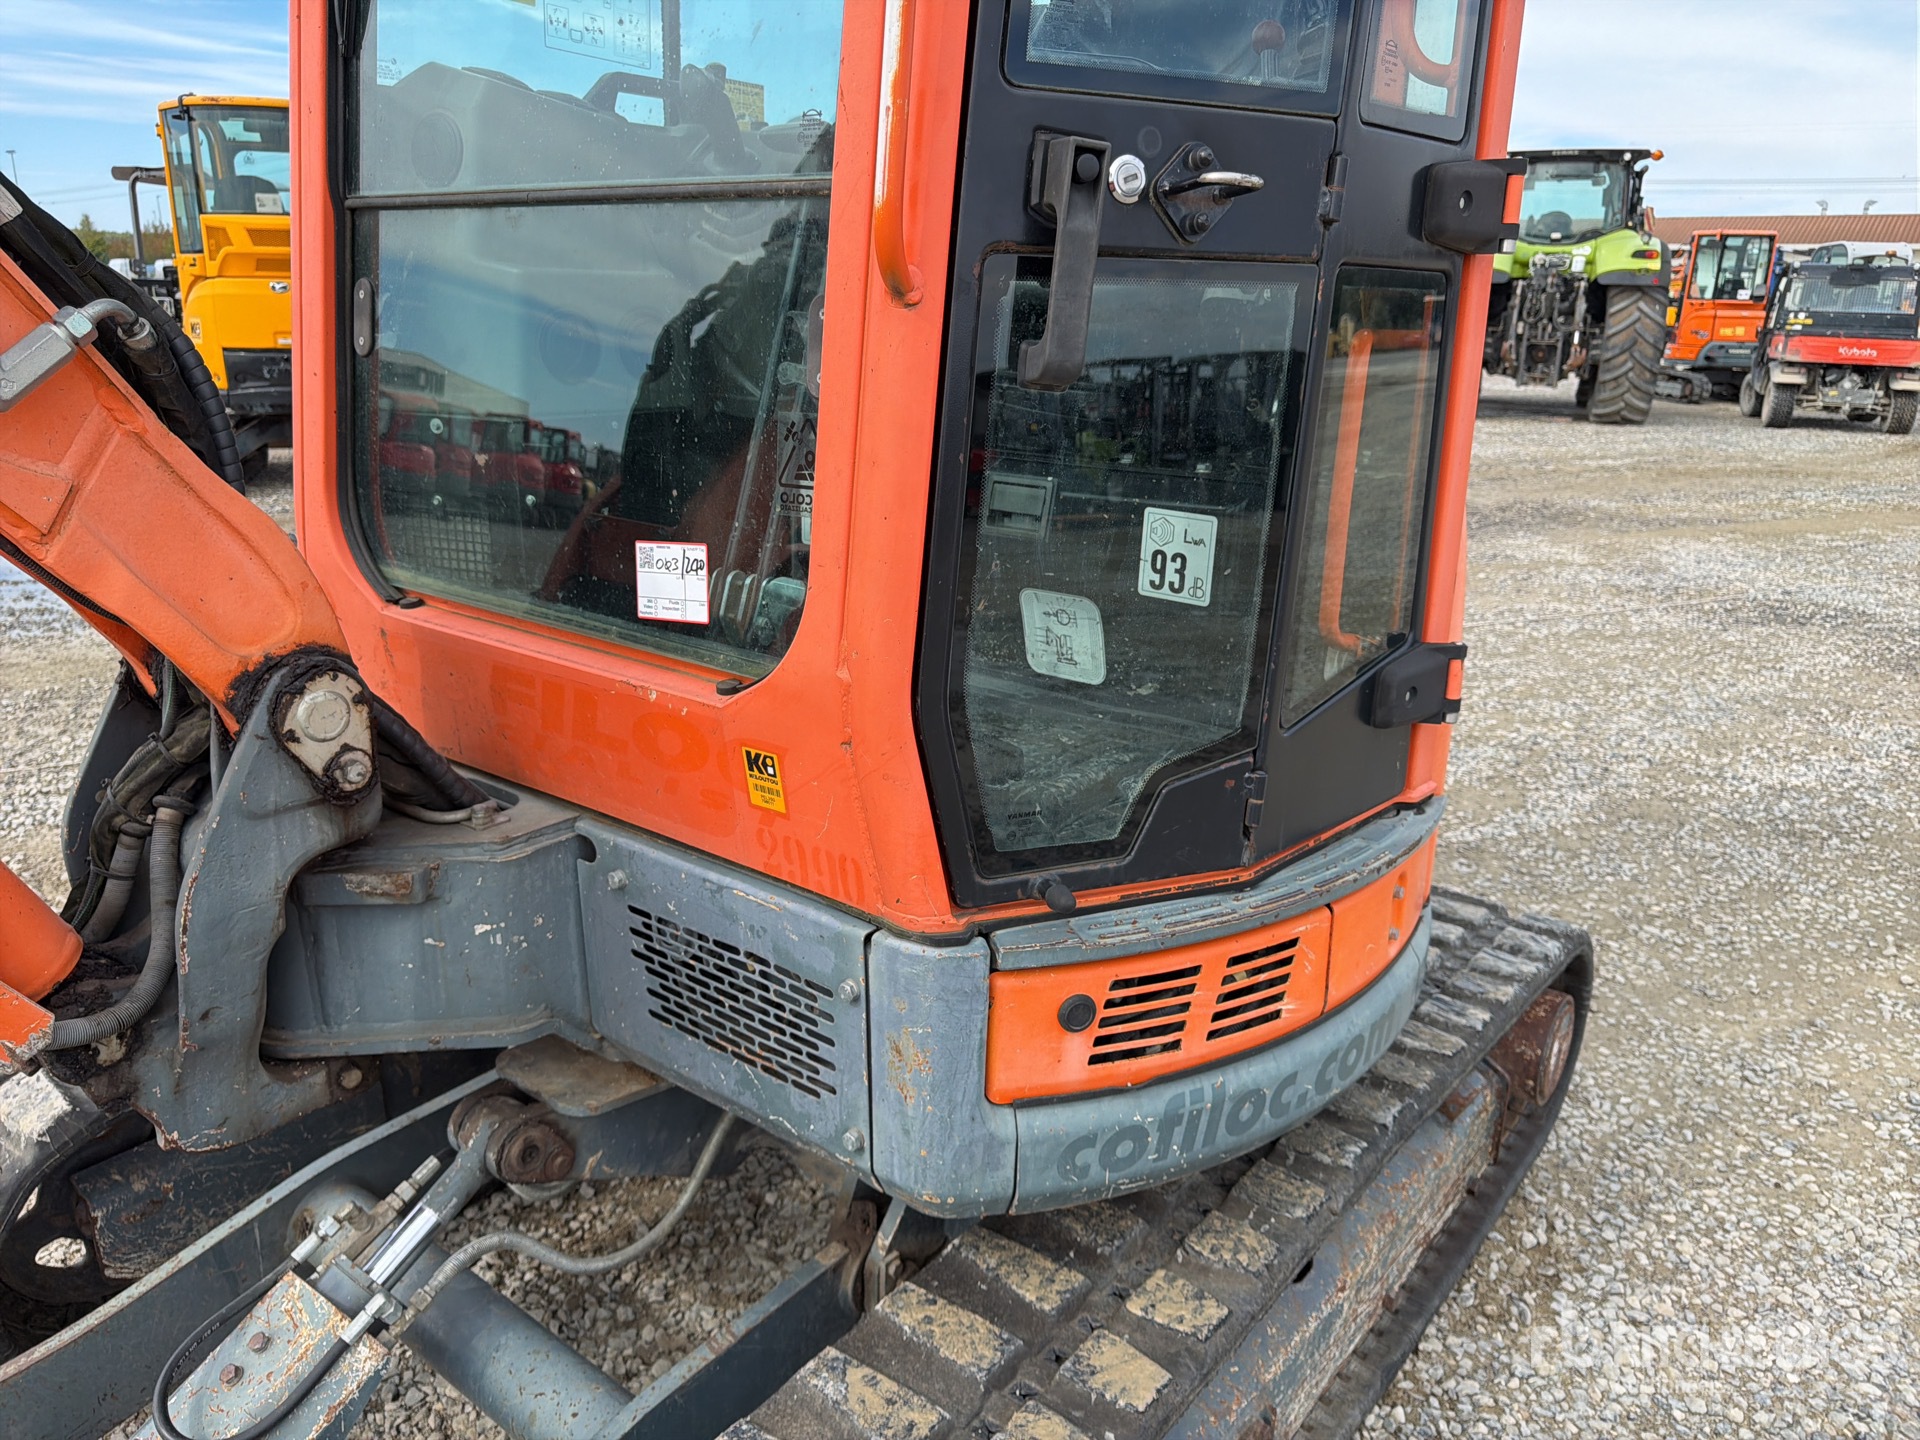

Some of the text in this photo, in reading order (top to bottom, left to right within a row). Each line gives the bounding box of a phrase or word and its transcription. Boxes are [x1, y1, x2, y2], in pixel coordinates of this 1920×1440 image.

[1838, 346, 1878, 358] Kubota
[1149, 549, 1205, 599] 93 dB
[1007, 810, 1043, 820] YANMAR
[1056, 1003, 1396, 1183] cofiloc.com
